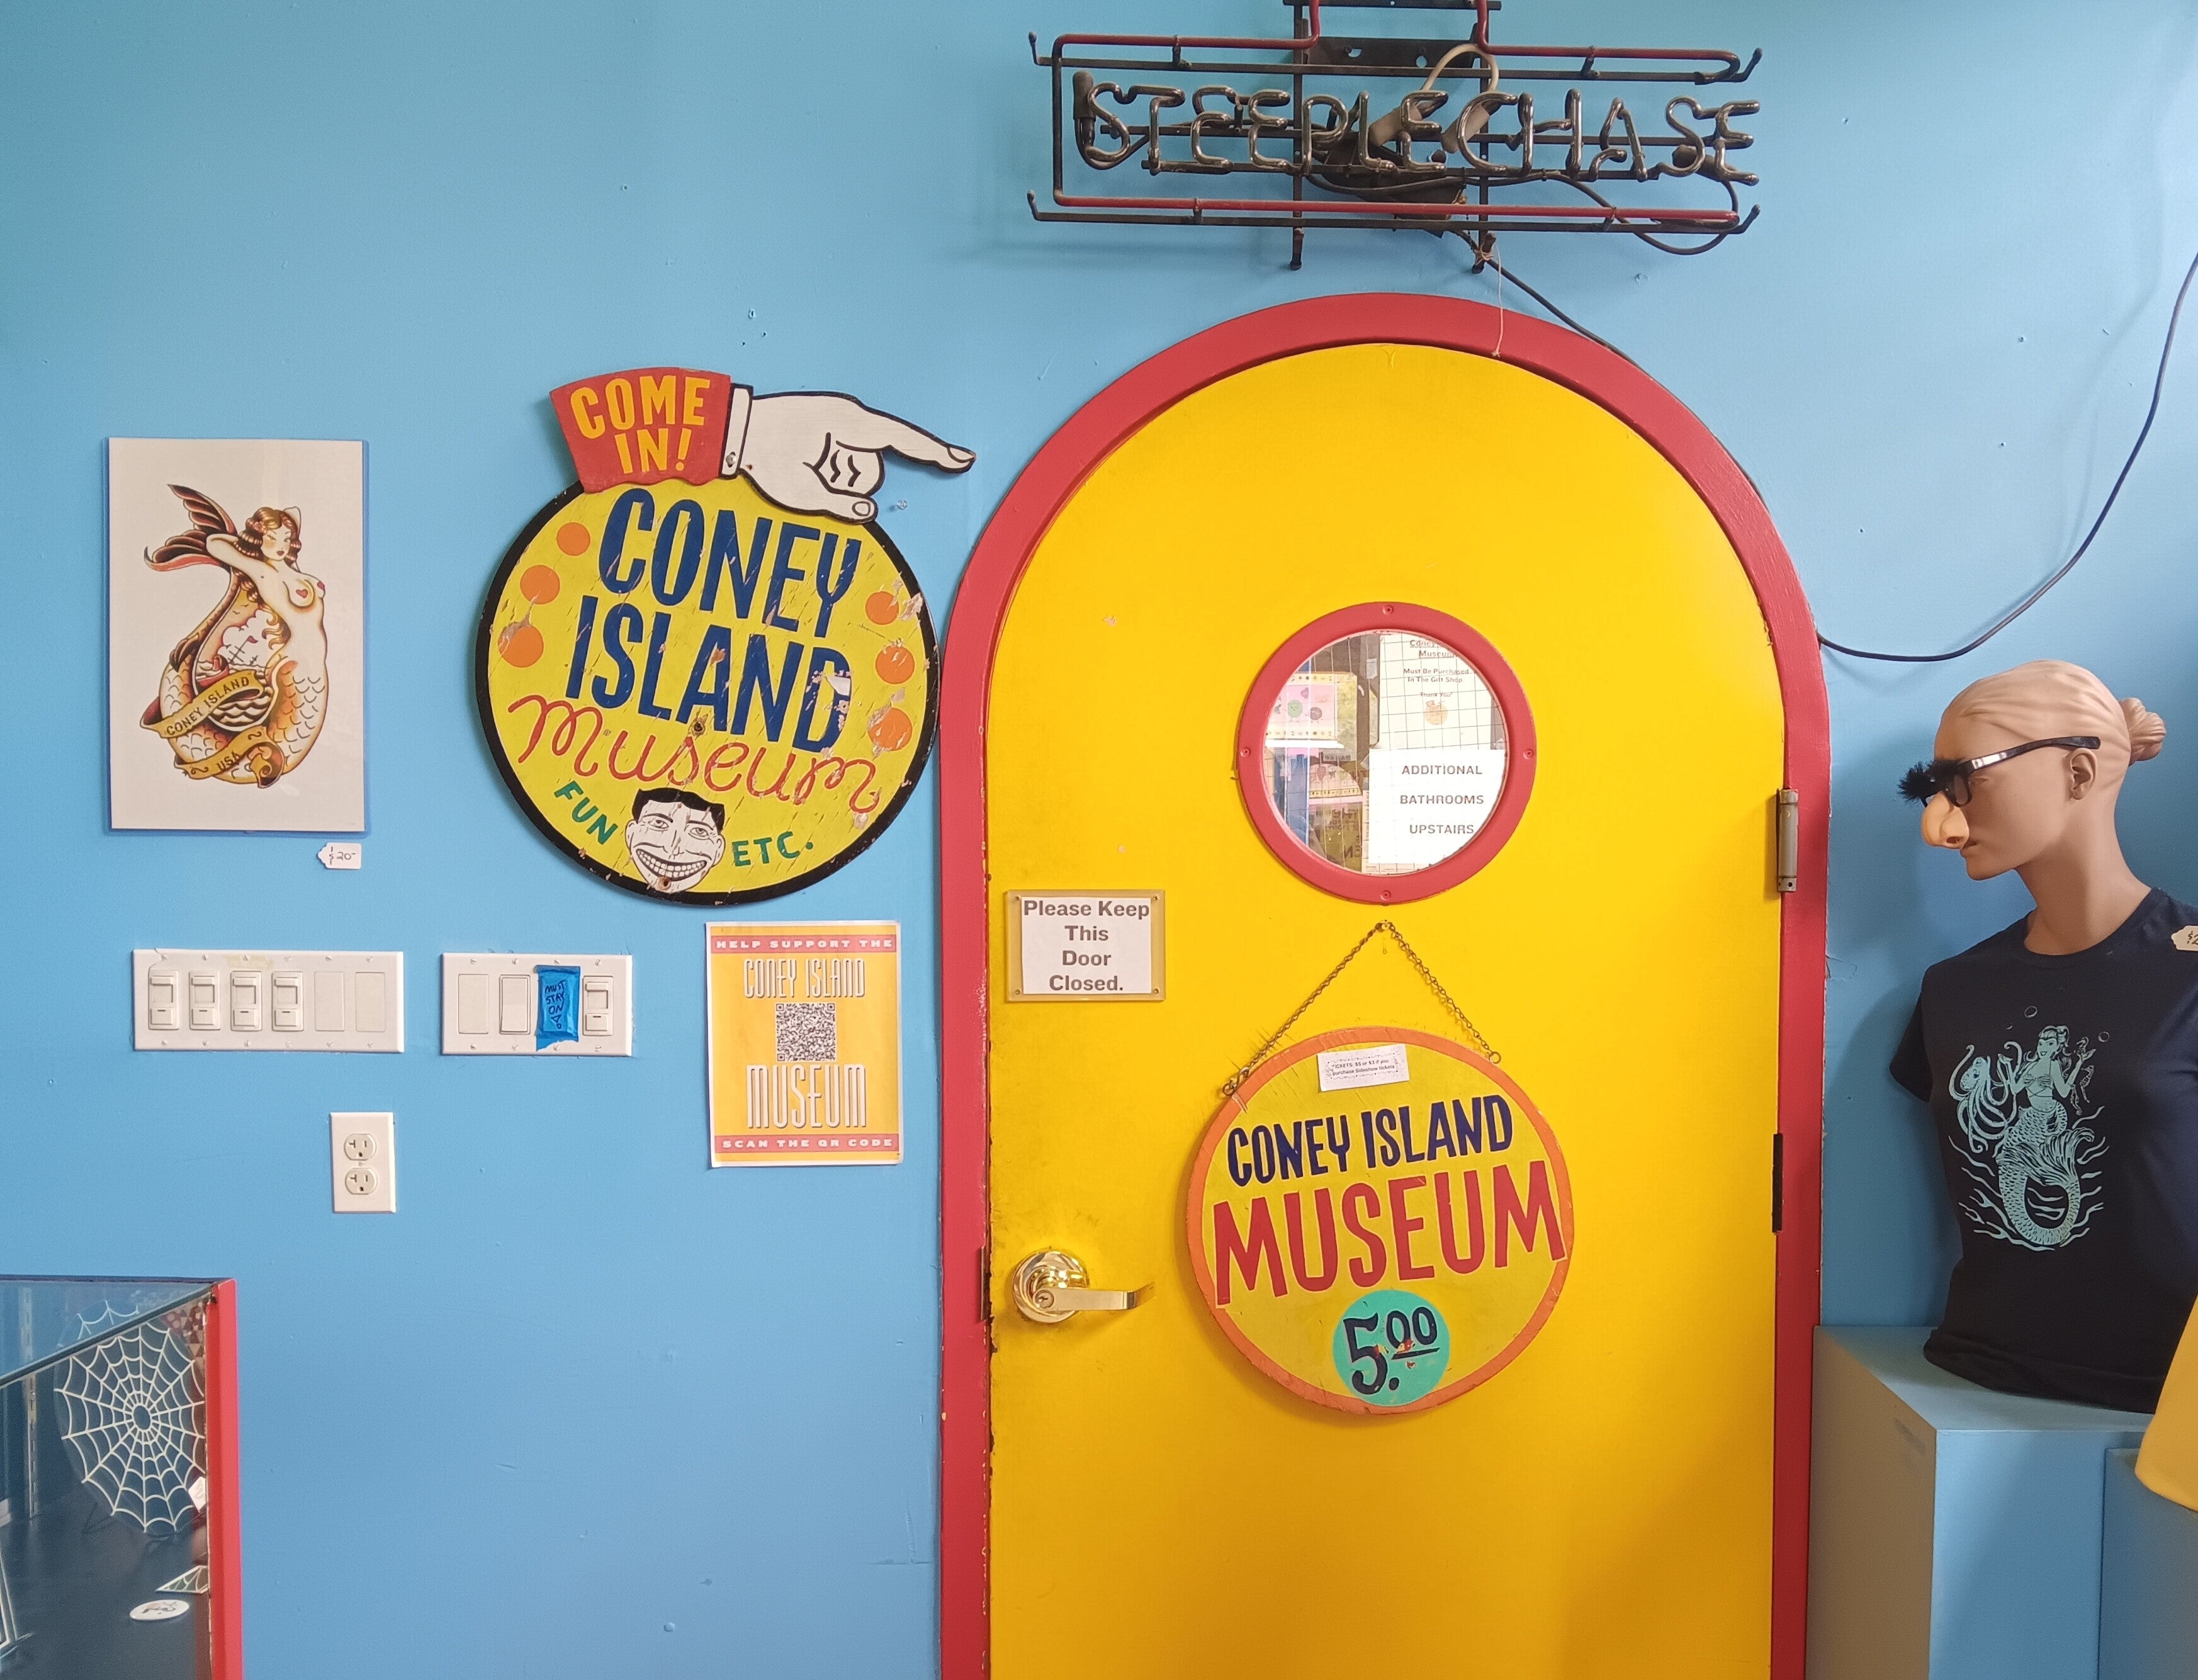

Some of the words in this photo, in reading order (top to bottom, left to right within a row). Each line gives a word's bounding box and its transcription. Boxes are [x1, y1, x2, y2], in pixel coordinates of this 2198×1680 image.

[1087, 83, 1761, 186] STEEPLECHASE
[570, 375, 711, 439] COME
[613, 427, 692, 475] IN!
[598, 488, 862, 638] CONEY
[565, 595, 852, 753] ISLAND
[166, 706, 202, 736] CONEY
[205, 675, 250, 711] ISLAND
[215, 751, 241, 772] USA
[508, 694, 881, 814] Museum
[1401, 764, 1483, 775] ADDITIONAL
[553, 779, 619, 846] FUN
[1400, 794, 1484, 804] BATHROOMS
[1409, 825, 1474, 834] UPSTAIRS
[732, 830, 814, 867] ETC.
[1023, 900, 1091, 916] Please
[1098, 900, 1149, 920] Keep
[716, 940, 761, 949] HELP
[769, 940, 850, 949] SUPPORT
[859, 939, 893, 948] THE
[1064, 925, 1109, 941] This
[1062, 950, 1112, 966] Door
[544, 979, 566, 994] MUST
[743, 957, 797, 998] CONEY
[804, 957, 865, 998] ISLAND
[1049, 974, 1124, 991] Closed.
[545, 990, 565, 1005] STAY
[548, 1003, 563, 1016] ON
[746, 1064, 867, 1129] MUSEUM
[722, 1139, 769, 1149] SCAN
[777, 1139, 810, 1148] THE
[818, 1139, 840, 1147] QR
[848, 1138, 893, 1147] CODE
[1227, 1113, 1351, 1188] CONEY
[1361, 1093, 1513, 1170] ISLAND
[1212, 1159, 1567, 1307] MUSEUM
[1342, 1305, 1440, 1395] 5.00
